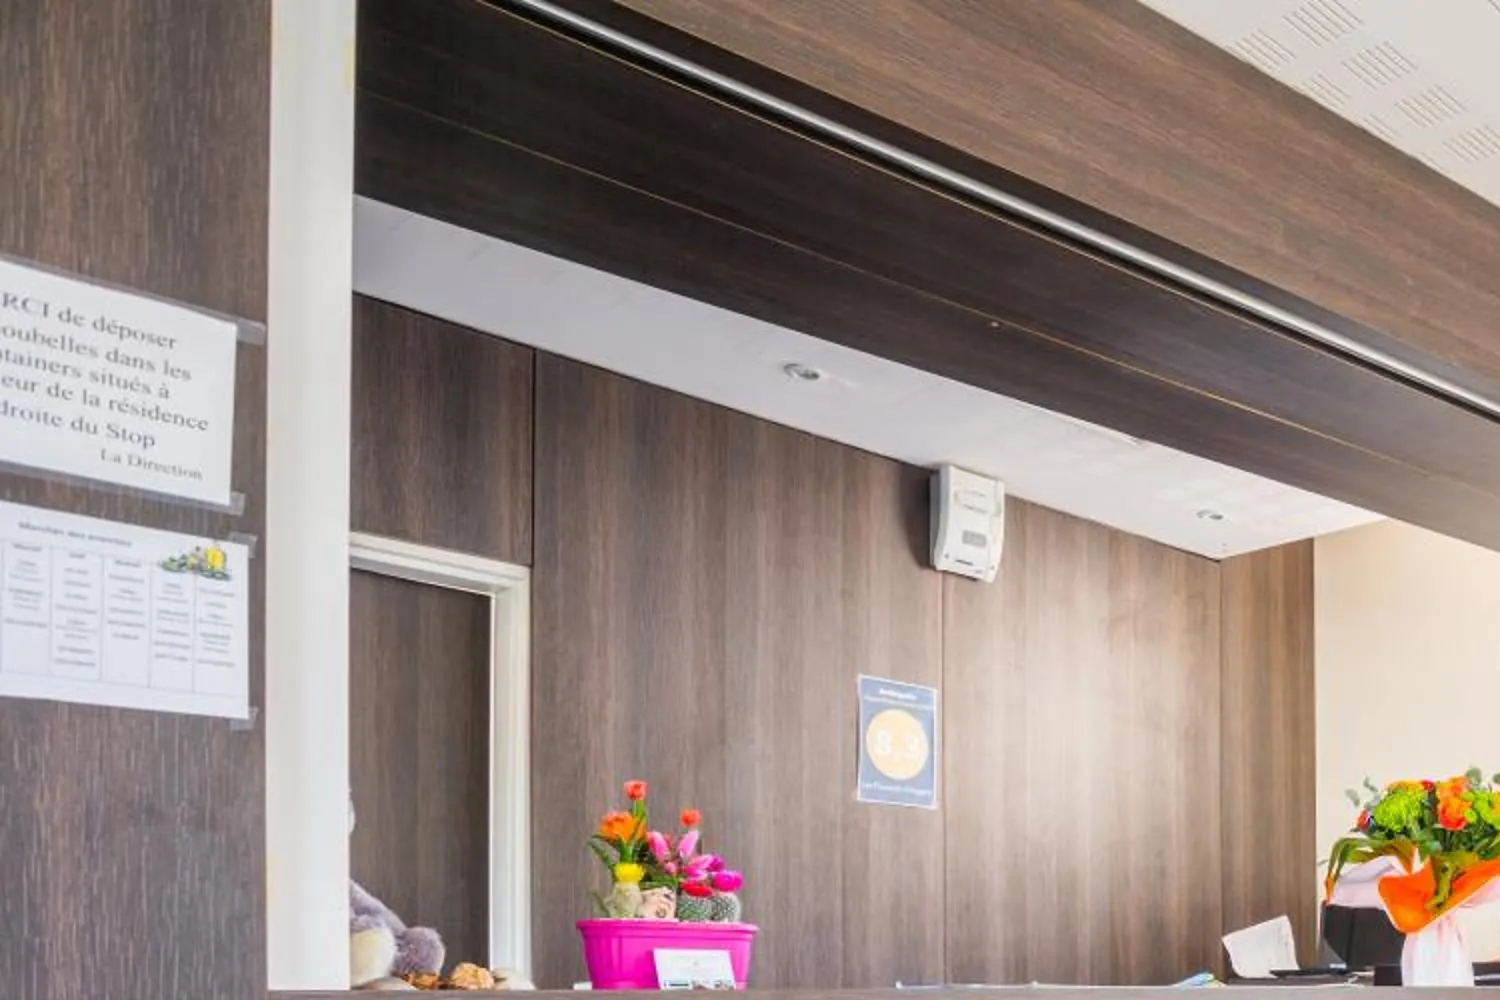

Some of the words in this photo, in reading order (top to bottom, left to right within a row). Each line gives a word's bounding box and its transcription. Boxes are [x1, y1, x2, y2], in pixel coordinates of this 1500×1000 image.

[58, 306, 86, 328] de
[92, 315, 177, 349] déposer
[0, 347, 82, 379] tainers
[88, 368, 152, 395] situés
[158, 382, 170, 400] à
[105, 348, 156, 373] dans
[163, 359, 192, 381] les
[47, 381, 74, 401] de
[82, 388, 100, 407] la
[108, 398, 209, 431] résidence
[71, 416, 99, 435] du
[105, 423, 156, 449] Stop
[100, 448, 122, 464] La
[127, 453, 203, 480] Direction
